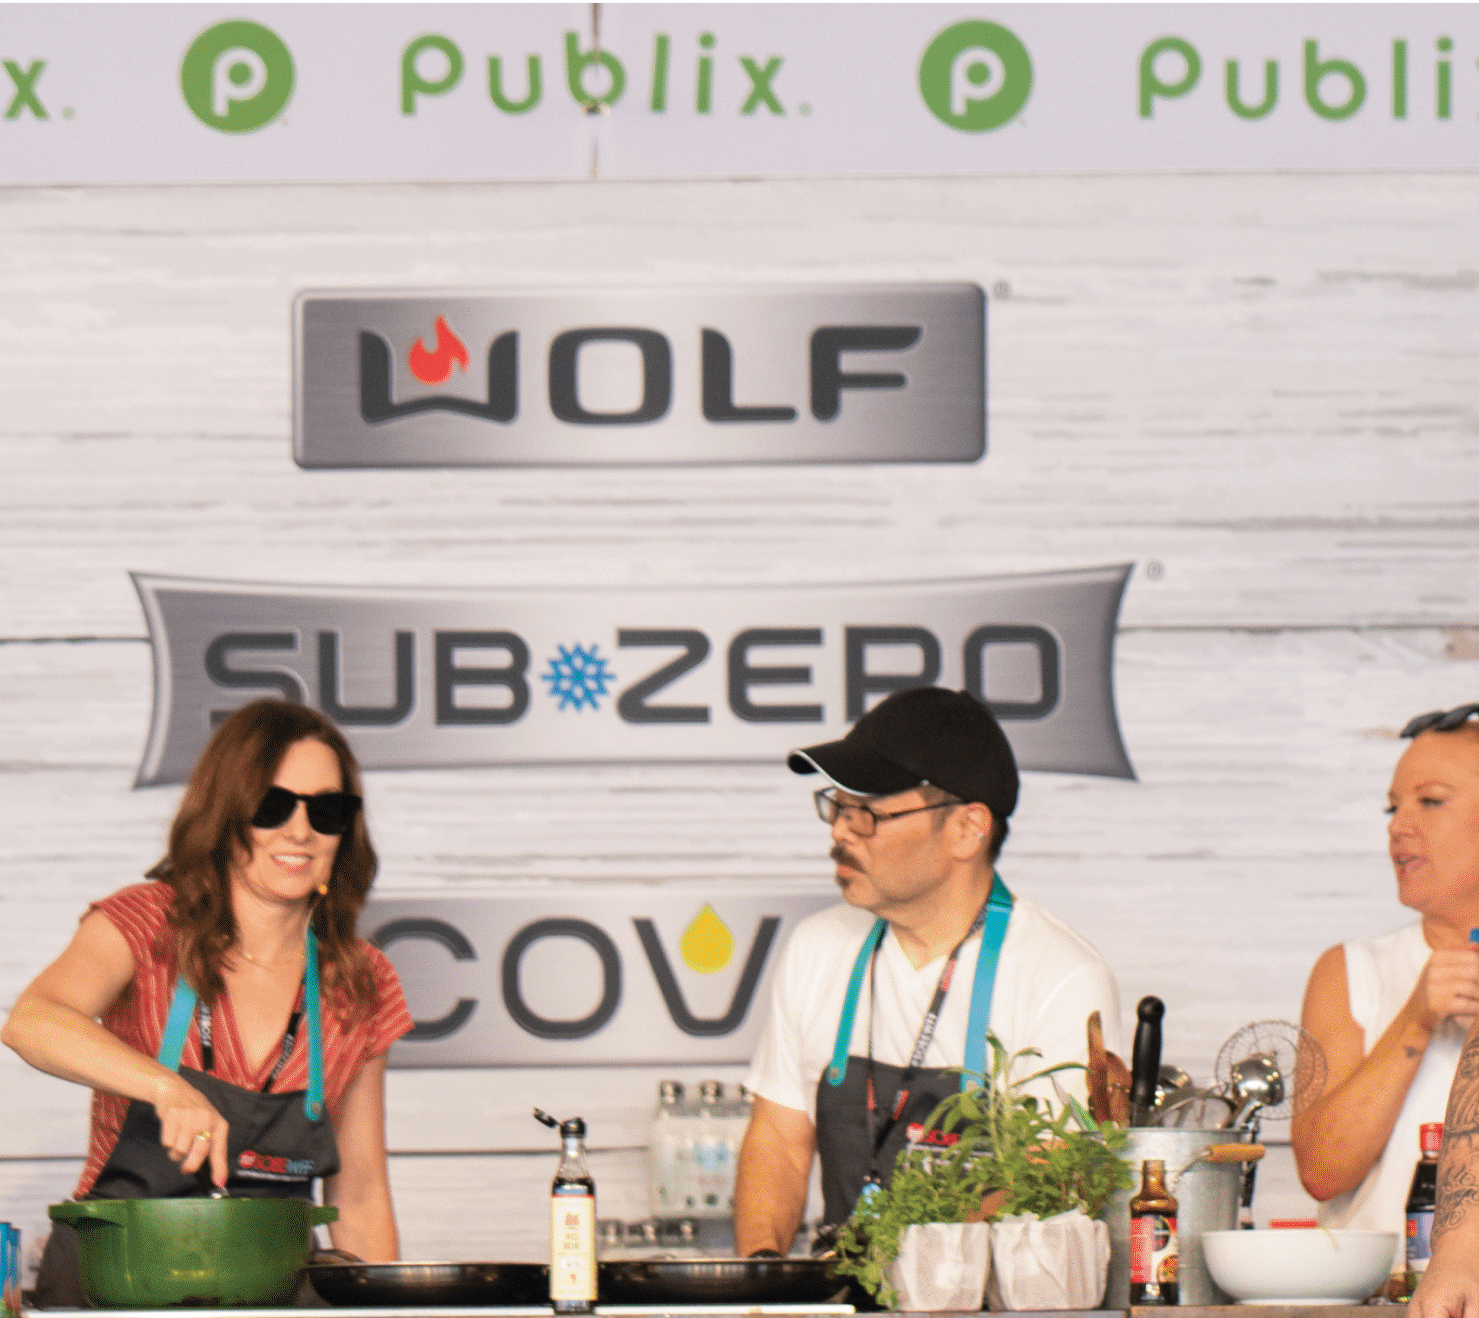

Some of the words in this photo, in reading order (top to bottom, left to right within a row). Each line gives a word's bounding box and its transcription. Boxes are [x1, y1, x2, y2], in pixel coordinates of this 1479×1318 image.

[400, 31, 785, 116] Publix
[355, 324, 924, 427] WOLF
[371, 916, 782, 1041] COV
